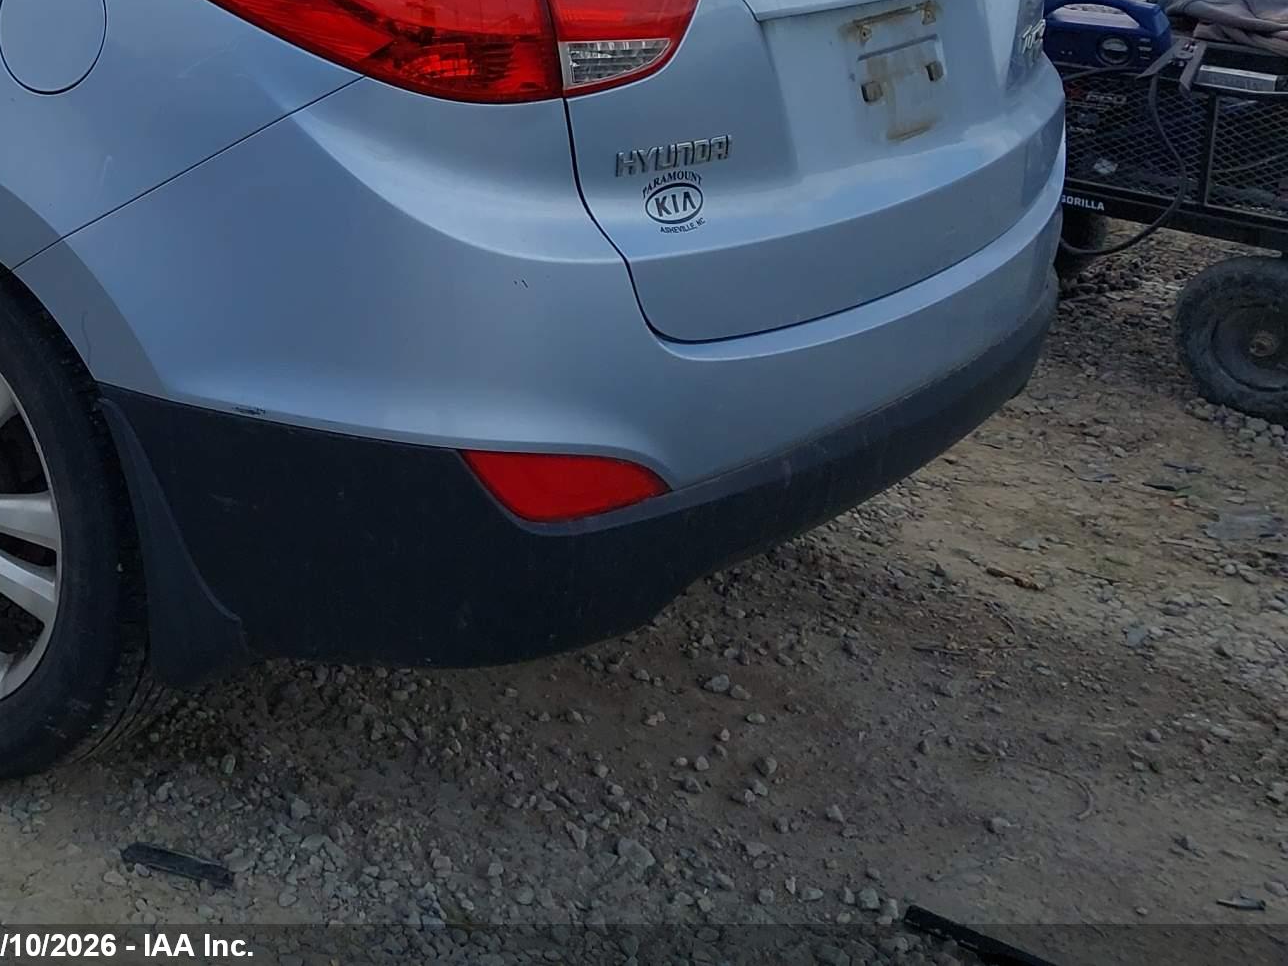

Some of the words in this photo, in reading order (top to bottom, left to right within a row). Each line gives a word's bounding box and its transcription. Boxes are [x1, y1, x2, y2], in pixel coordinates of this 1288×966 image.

[615, 134, 732, 178] HYUNDAI
[642, 169, 703, 199] PARAMOUNT
[654, 191, 697, 217] KIA
